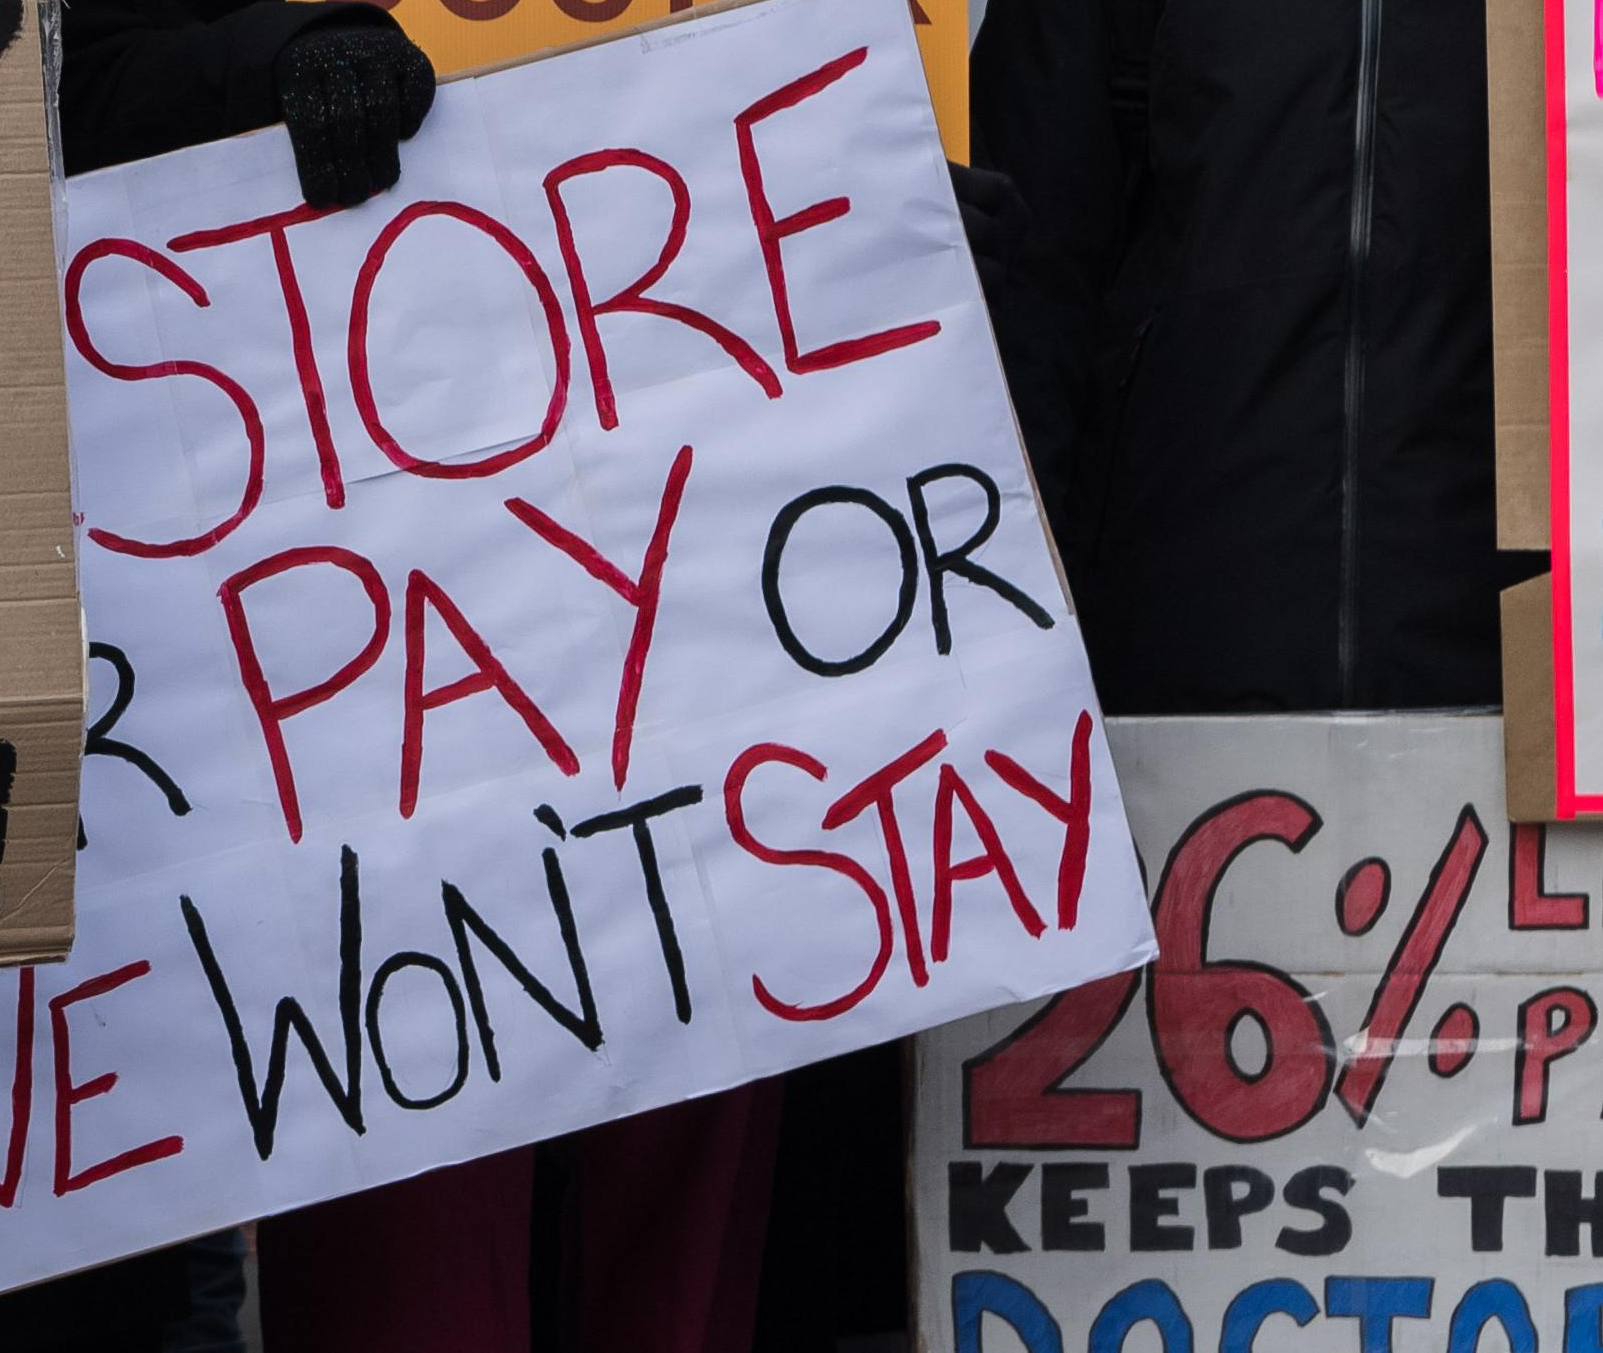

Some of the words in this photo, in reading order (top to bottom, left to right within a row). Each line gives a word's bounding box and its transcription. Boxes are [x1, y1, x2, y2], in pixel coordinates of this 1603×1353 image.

[65, 46, 942, 560] STORE
[218, 445, 692, 844] PAY
[761, 462, 1055, 678] OR
[724, 710, 1093, 1022] STAY
[948, 1161, 1356, 1256] KEEPS
[1436, 1166, 1603, 1257] TH
